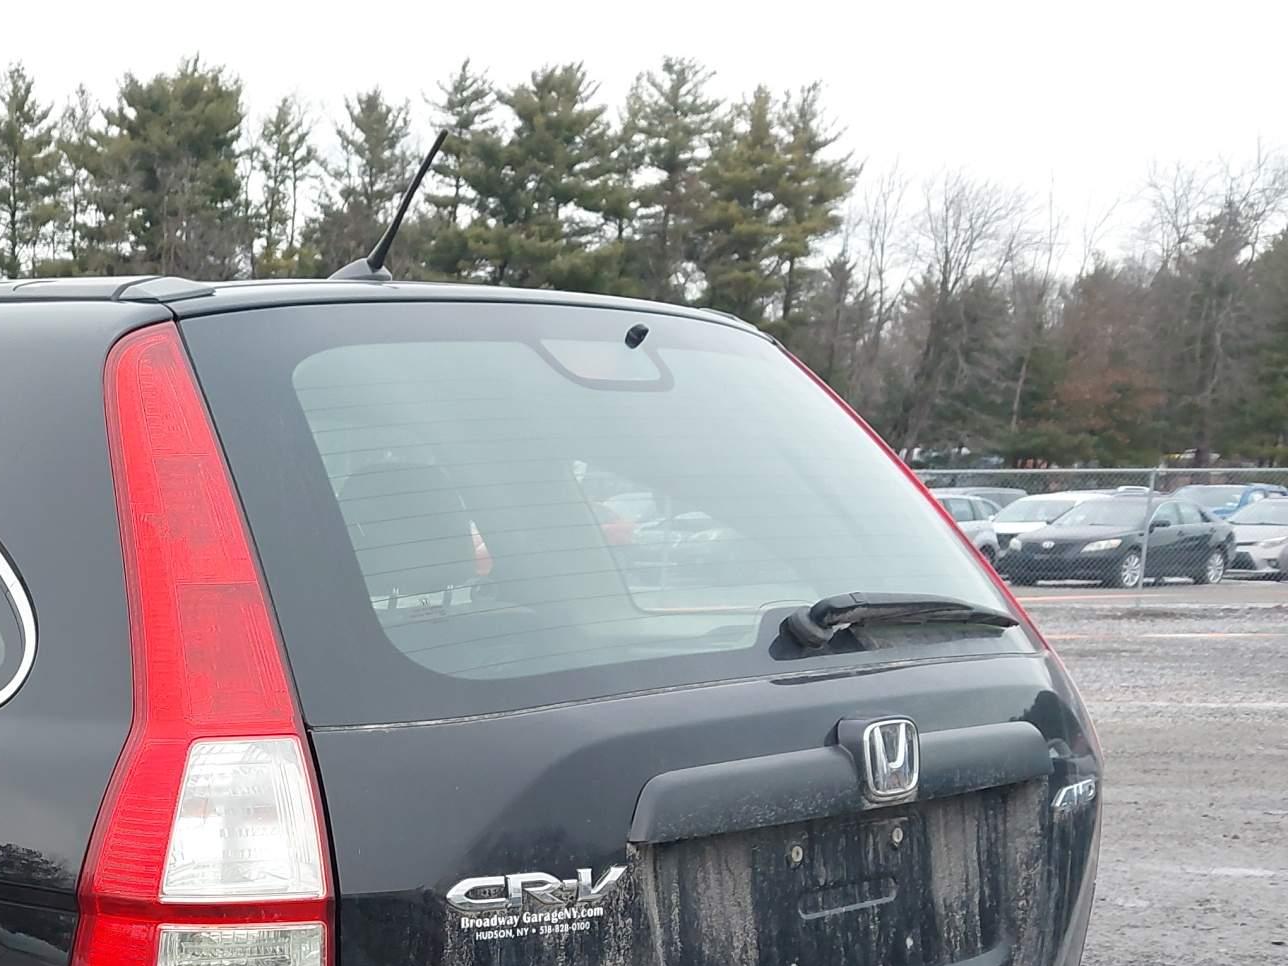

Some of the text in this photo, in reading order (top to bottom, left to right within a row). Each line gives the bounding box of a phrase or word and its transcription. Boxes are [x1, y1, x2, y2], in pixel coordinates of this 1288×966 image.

[446, 865, 628, 912] CR-V
[461, 907, 604, 929] Broadway GarageNY.com
[476, 921, 591, 941] HUDSON, NY 518-828-0100
